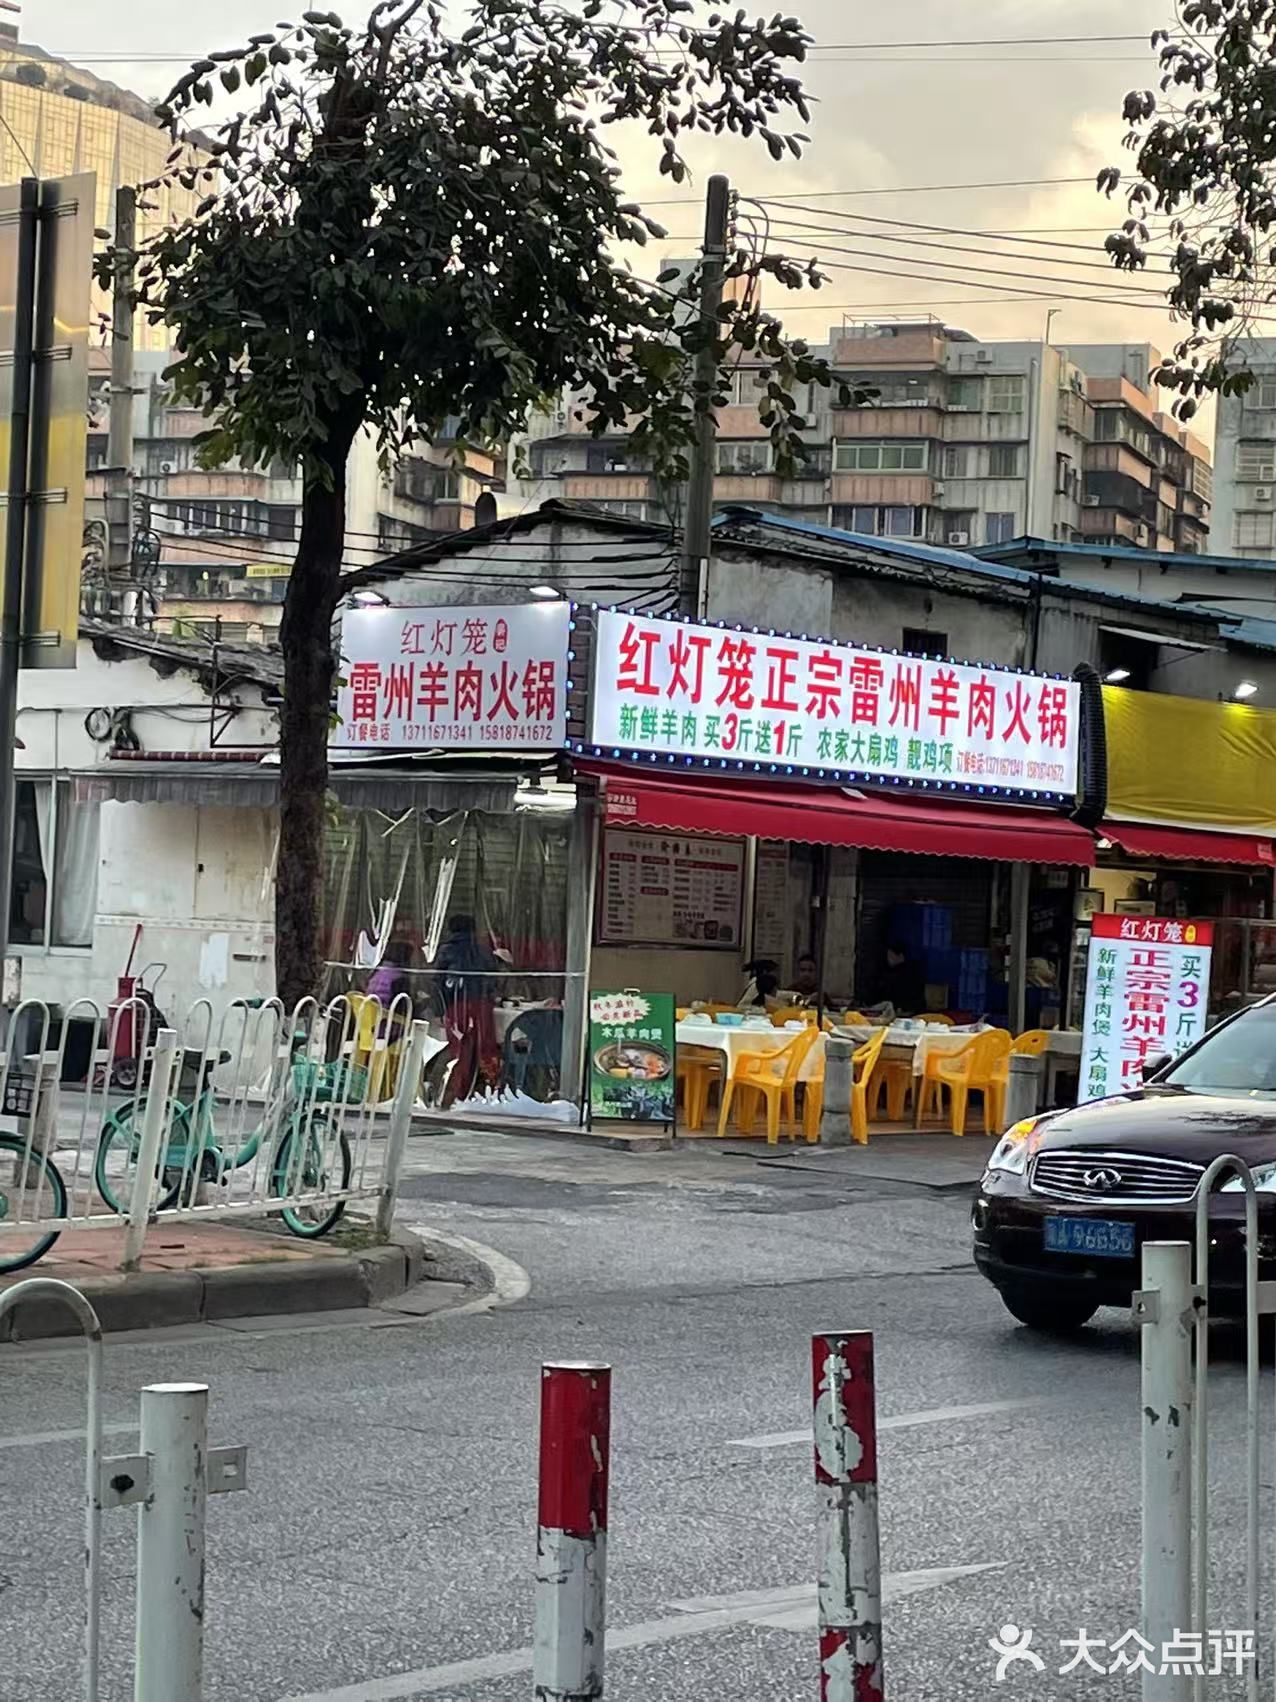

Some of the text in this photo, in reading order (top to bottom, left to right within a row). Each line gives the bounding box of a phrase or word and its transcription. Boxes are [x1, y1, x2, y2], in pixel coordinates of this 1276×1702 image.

[401, 618, 488, 656] 红灯笼
[350, 660, 555, 722] 雷州羊肉火锅
[616, 622, 1067, 749] 红灯笼正宗雷州羊肉火锅
[347, 723, 552, 742] 订餐电话 13711671341 15818741672
[816, 727, 898, 768] 农家大扇鸡
[1120, 918, 1183, 943] 红灯笼
